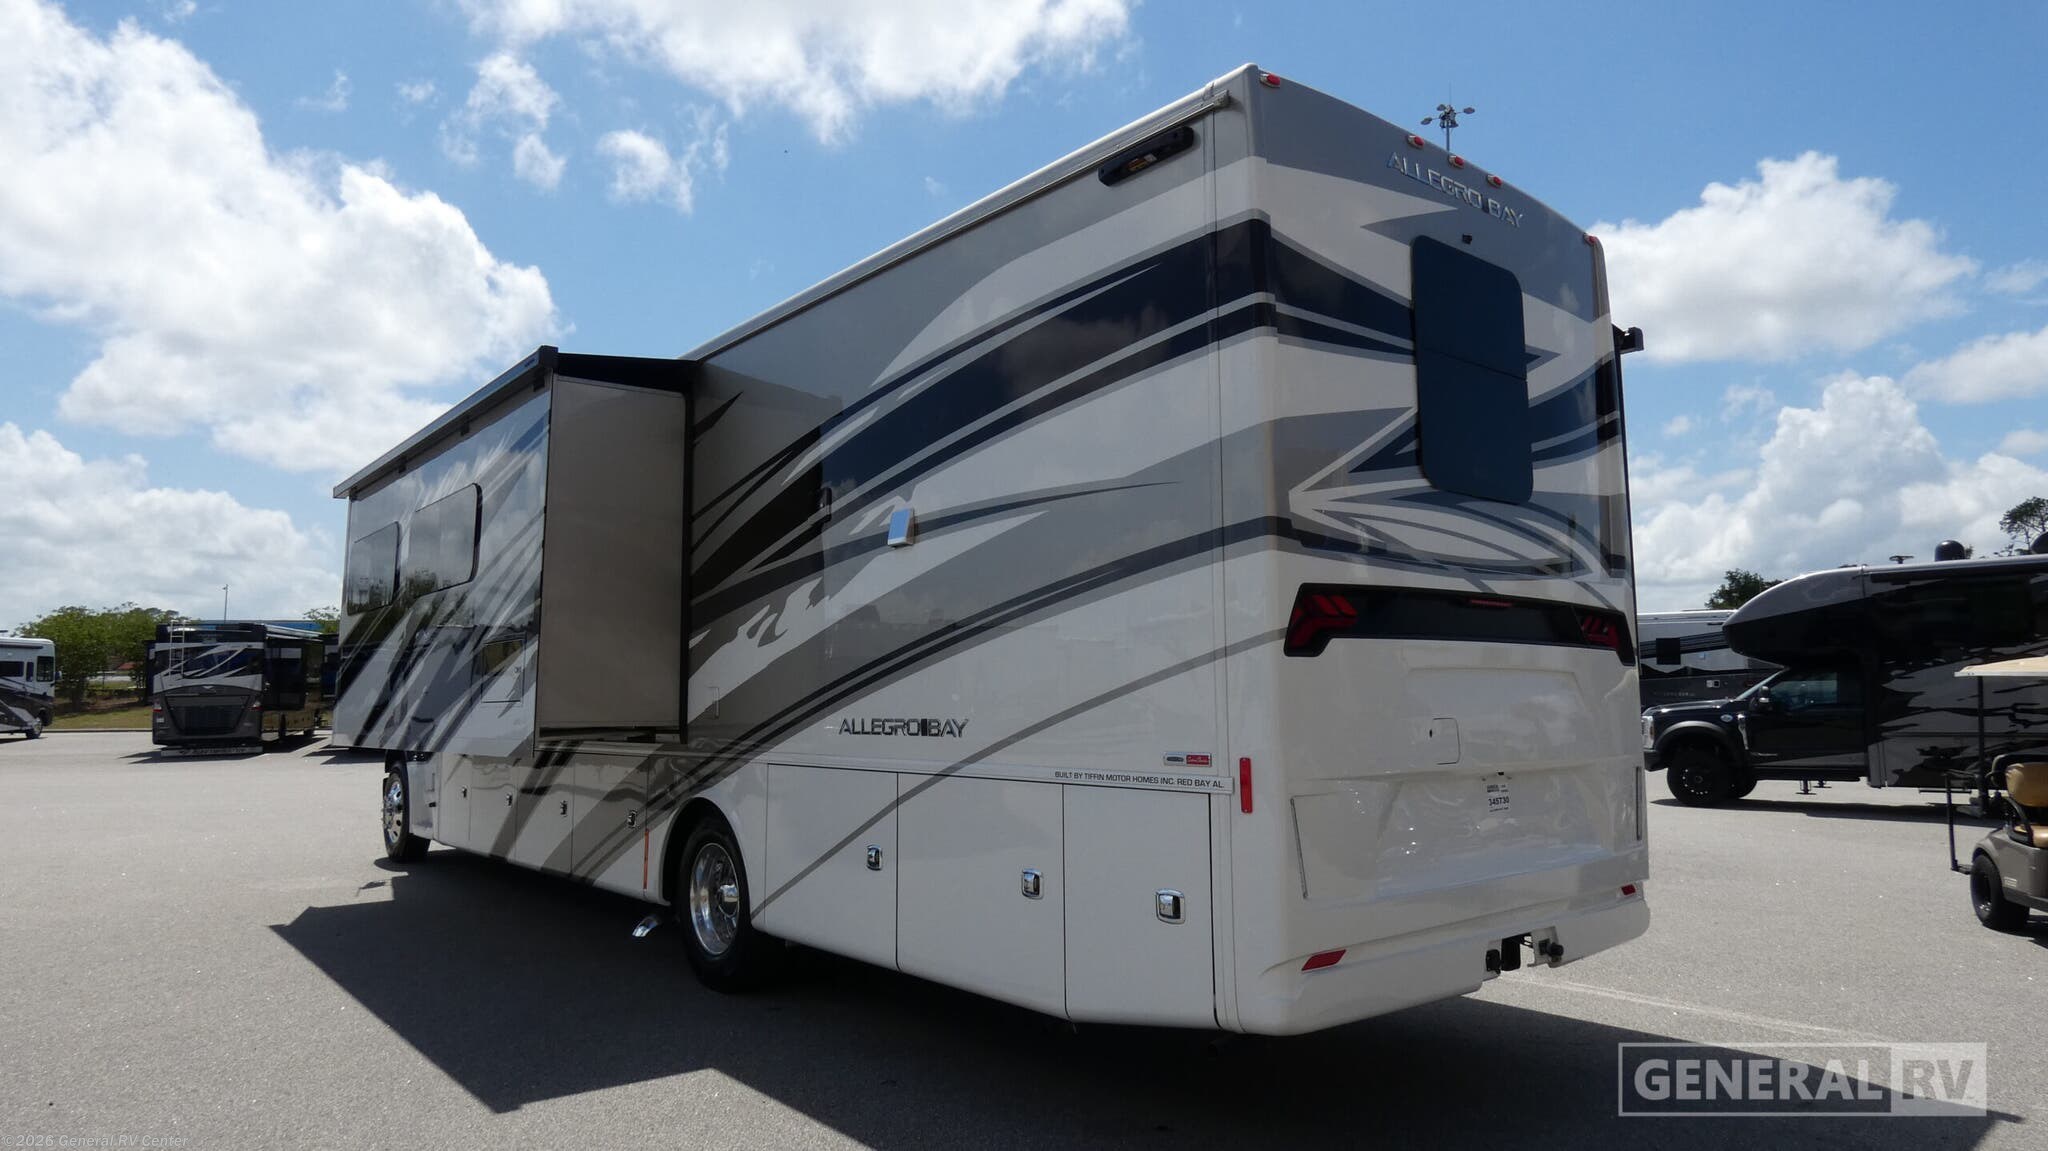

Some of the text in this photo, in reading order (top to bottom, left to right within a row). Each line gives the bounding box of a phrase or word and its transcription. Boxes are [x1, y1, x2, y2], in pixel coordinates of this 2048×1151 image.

[1387, 151, 1524, 228] ALLEGRO BAY
[839, 718, 969, 738] ALLEGRO BAY
[1054, 771, 1073, 779] BUILT
[1074, 772, 1083, 780] BY
[1084, 773, 1104, 781] TIFFIN
[1105, 773, 1131, 783] MOTOR
[1132, 775, 1159, 784] HOMES
[1177, 778, 1193, 787] RED
[1194, 779, 1212, 788] BAY
